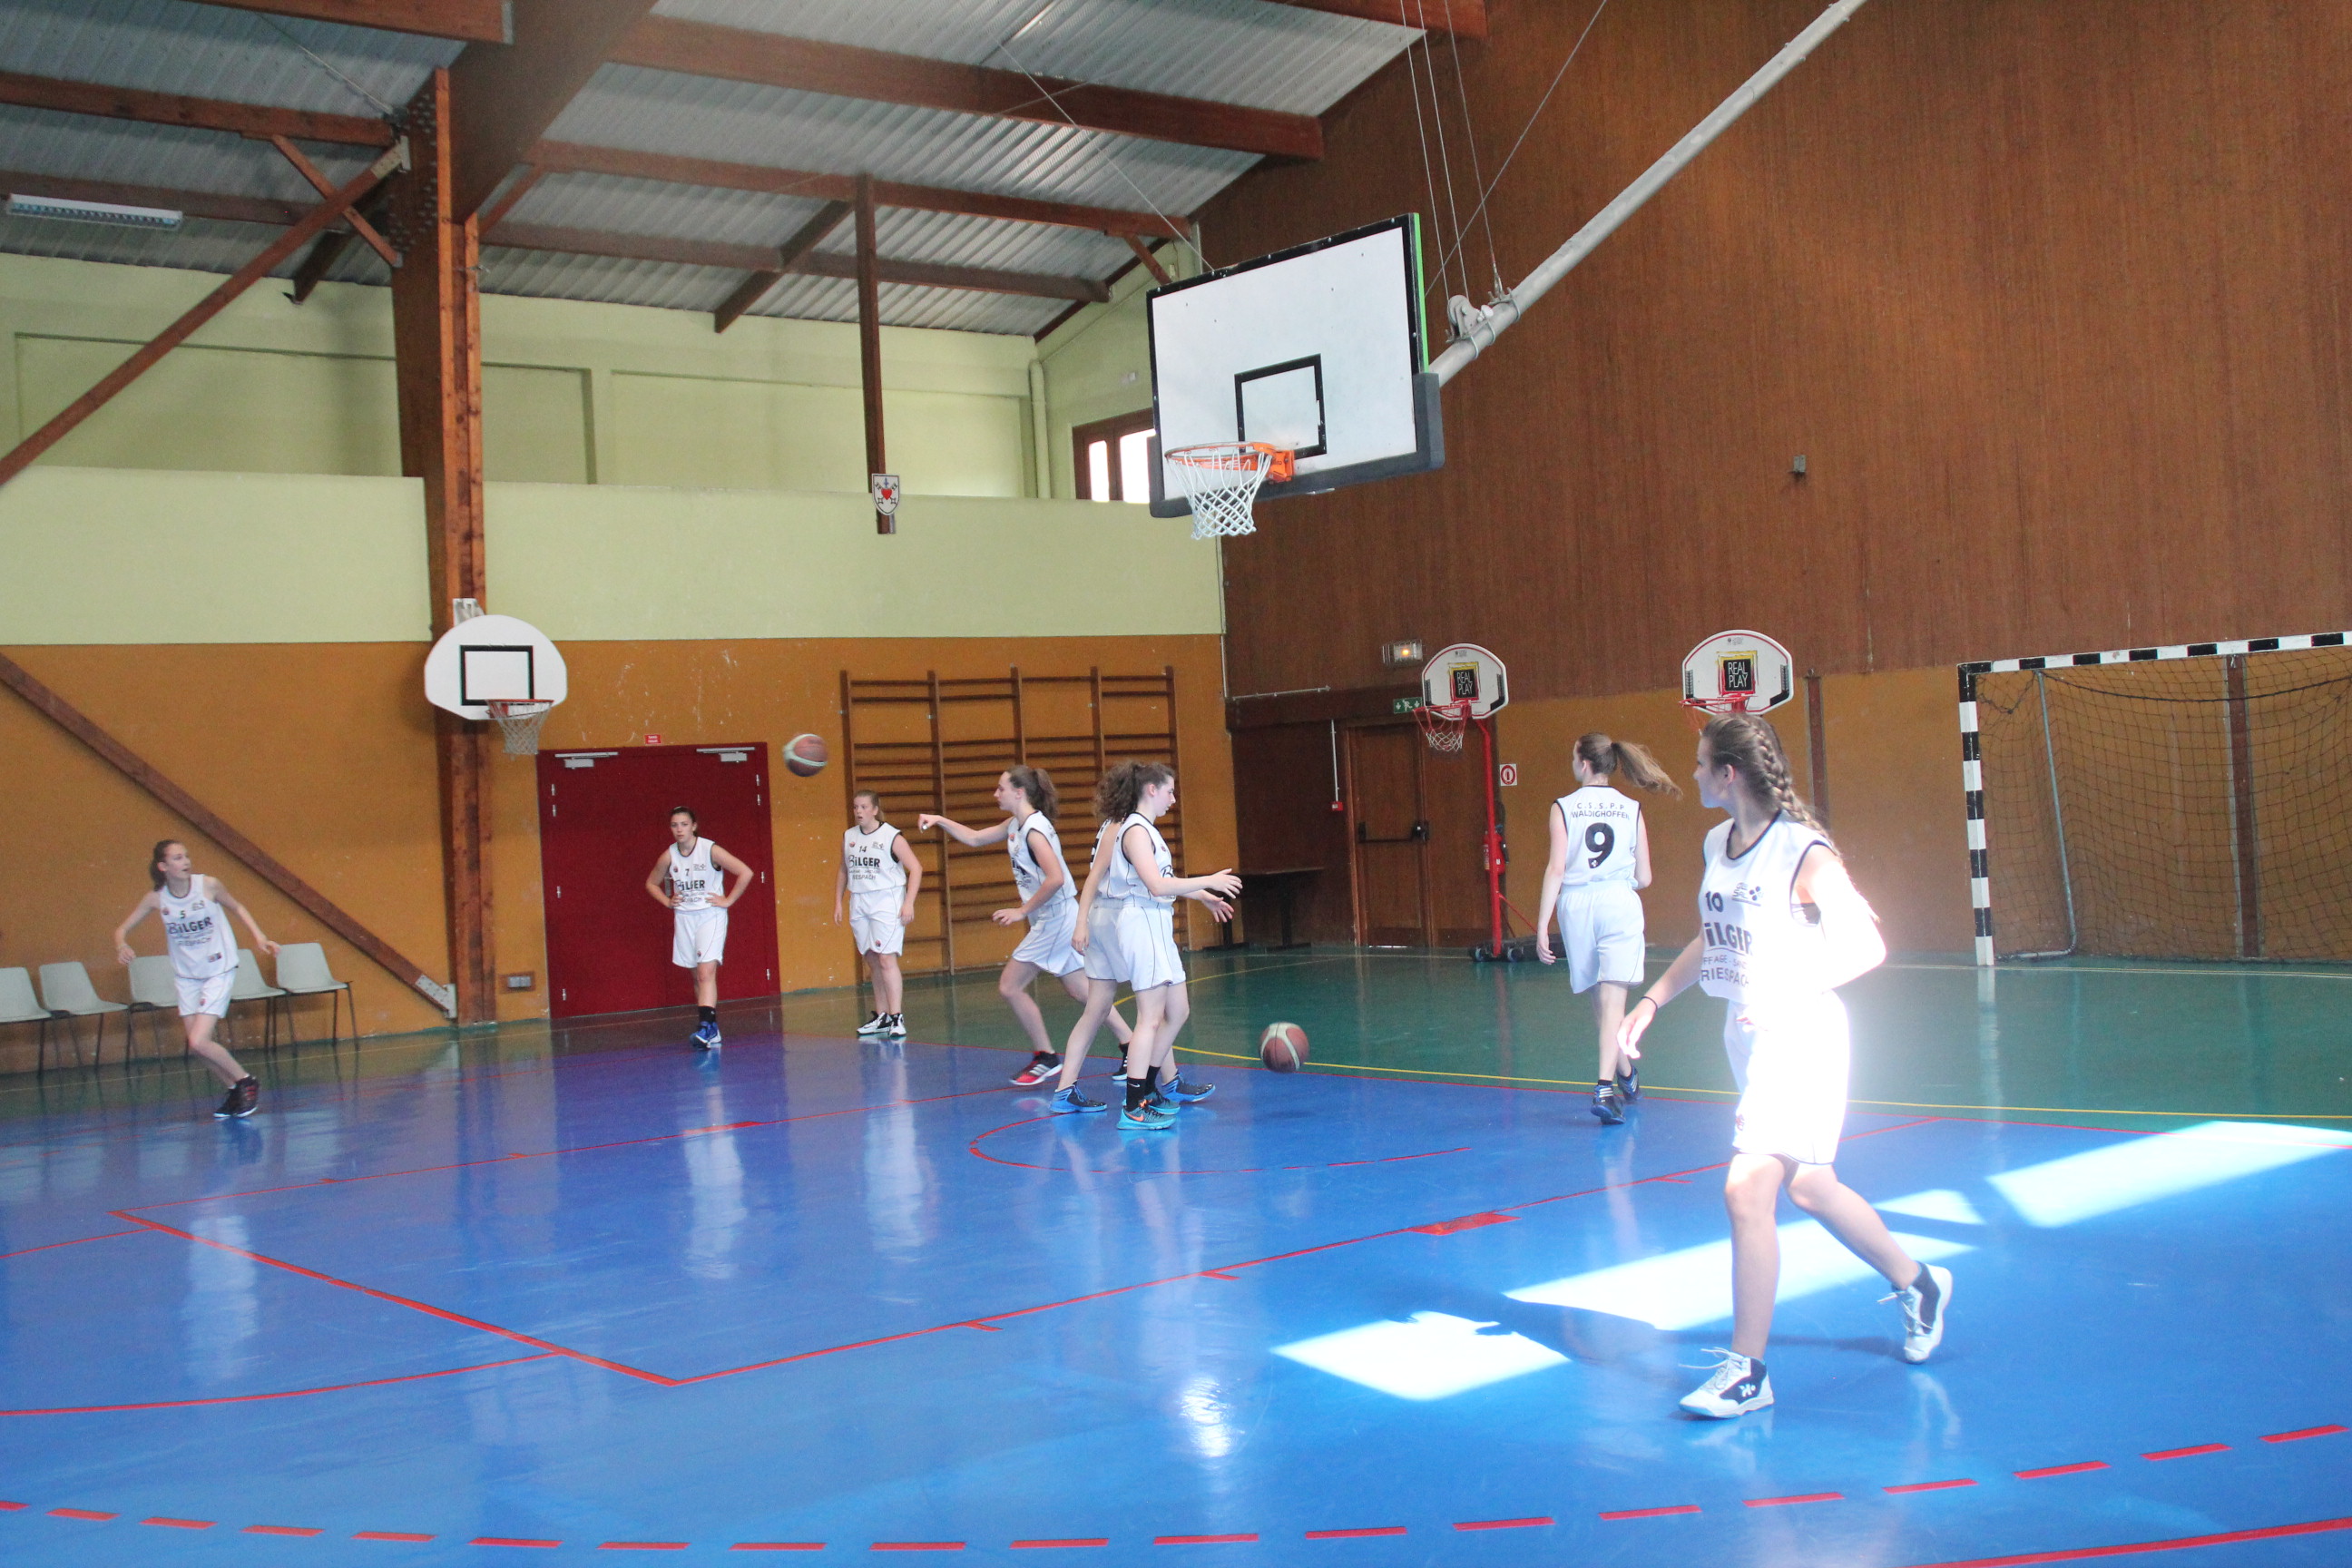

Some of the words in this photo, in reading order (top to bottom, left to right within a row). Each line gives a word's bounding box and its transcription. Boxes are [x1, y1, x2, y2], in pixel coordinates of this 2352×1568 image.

[1728, 662, 1748, 675] REAL
[1456, 671, 1473, 683] REAL
[1729, 674, 1748, 688] PLAY
[1457, 682, 1473, 695] PLAY
[1585, 822, 1614, 868] 9
[685, 868, 690, 877] 7
[1705, 891, 1724, 913] 10
[181, 910, 185, 919] 5
